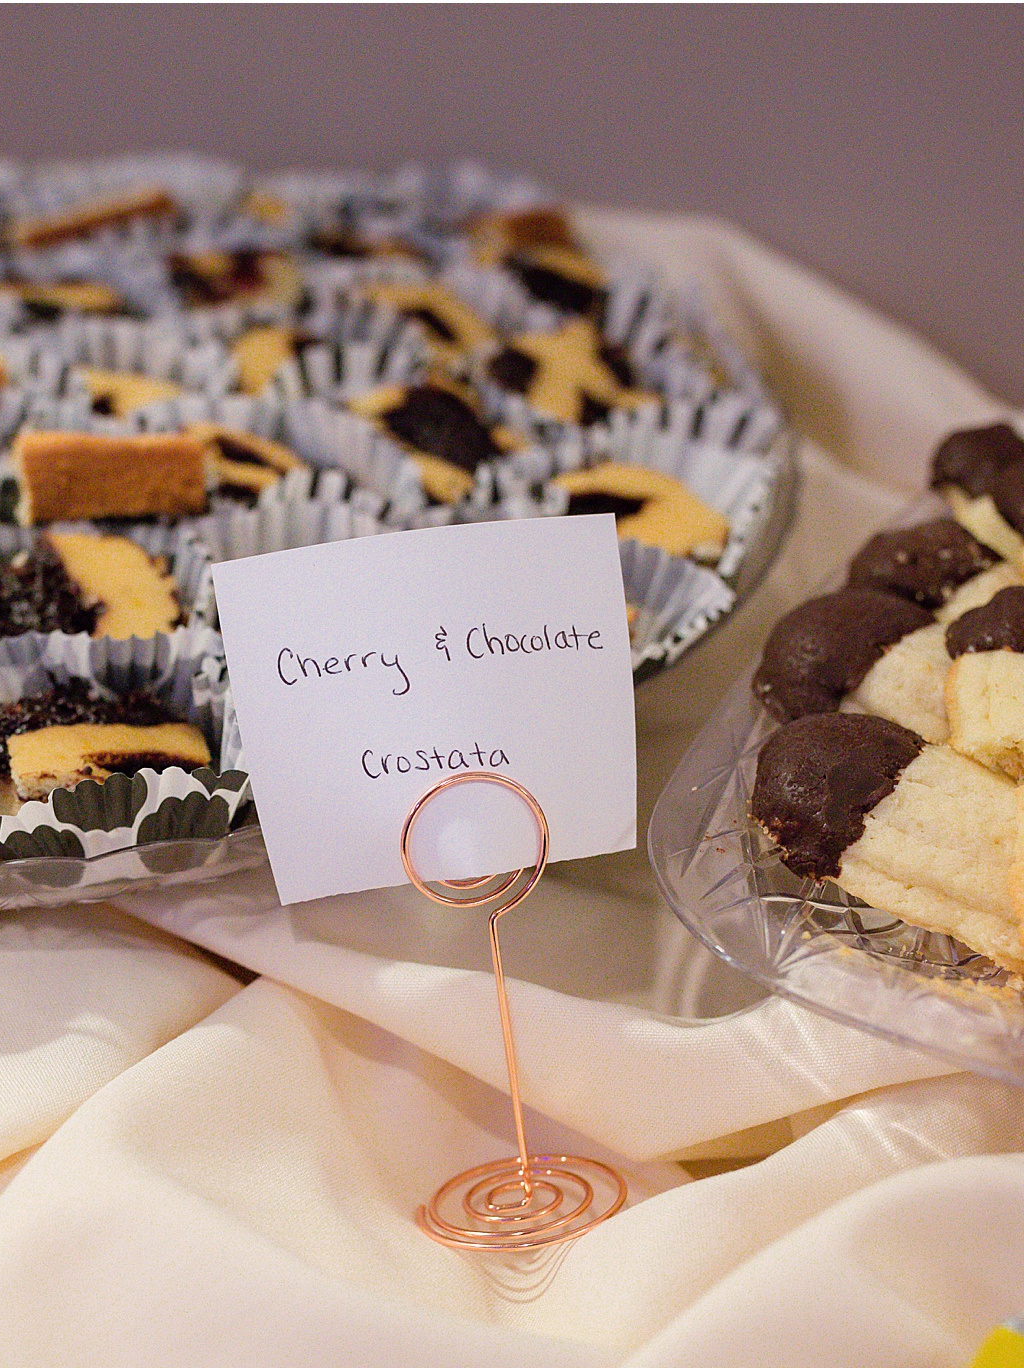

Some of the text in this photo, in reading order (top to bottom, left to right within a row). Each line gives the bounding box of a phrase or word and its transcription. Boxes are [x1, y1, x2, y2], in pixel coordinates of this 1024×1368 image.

[277, 623, 604, 696] Cherry & Chocolate
[361, 742, 510, 779] Crostata
